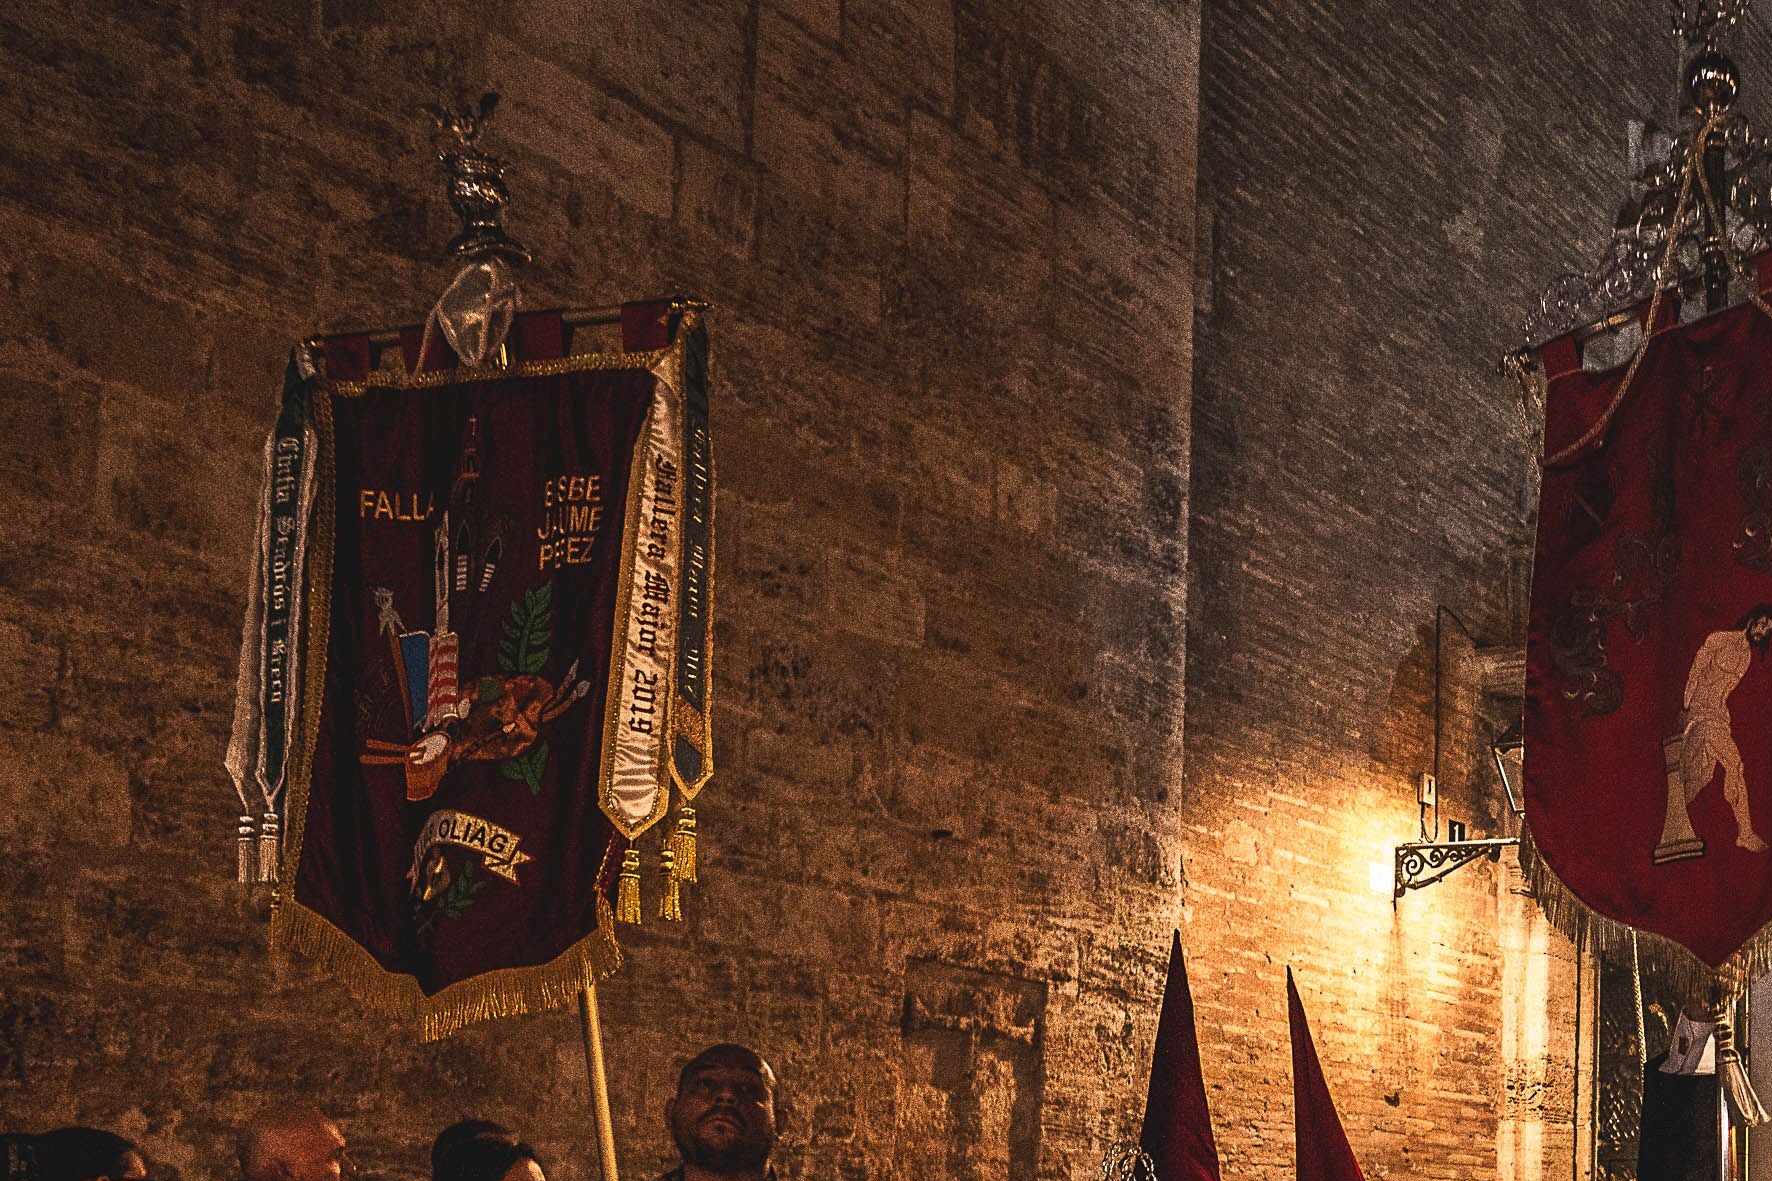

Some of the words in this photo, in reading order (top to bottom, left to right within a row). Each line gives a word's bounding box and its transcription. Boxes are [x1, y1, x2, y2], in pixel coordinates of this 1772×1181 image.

[648, 455, 677, 560] Fallera
[638, 570, 671, 657] Major
[629, 669, 659, 735] 2019
